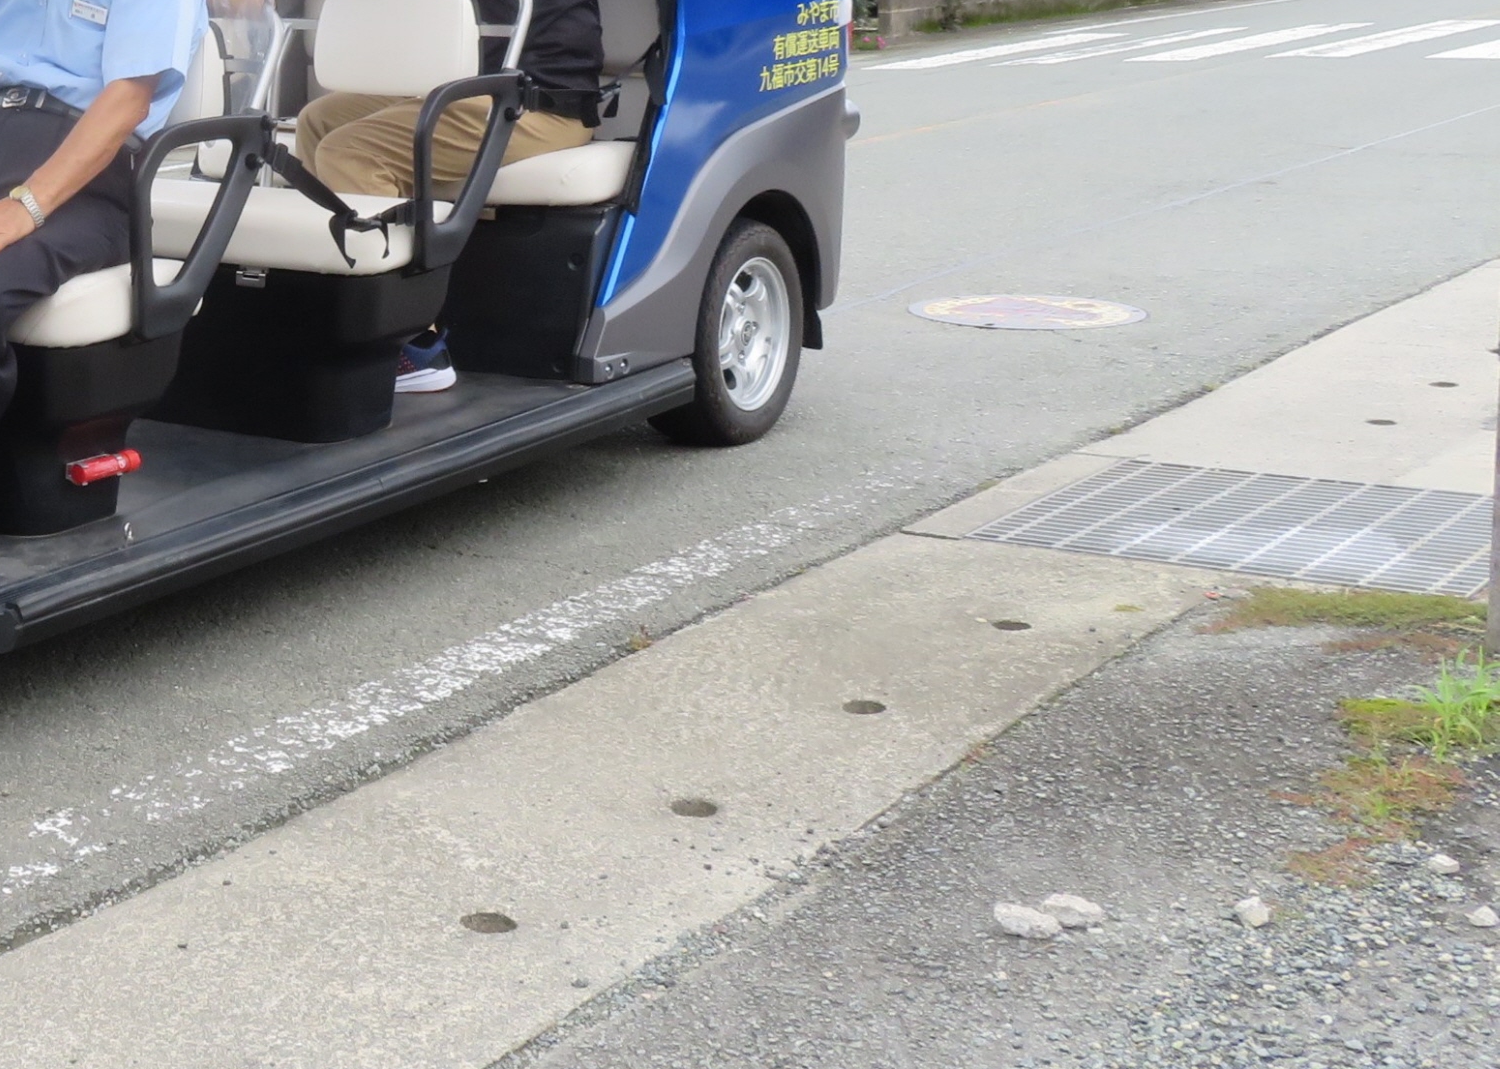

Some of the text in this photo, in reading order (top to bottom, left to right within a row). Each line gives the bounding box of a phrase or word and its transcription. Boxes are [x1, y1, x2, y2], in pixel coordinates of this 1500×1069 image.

[773, 26, 840, 61] 有償運送車両
